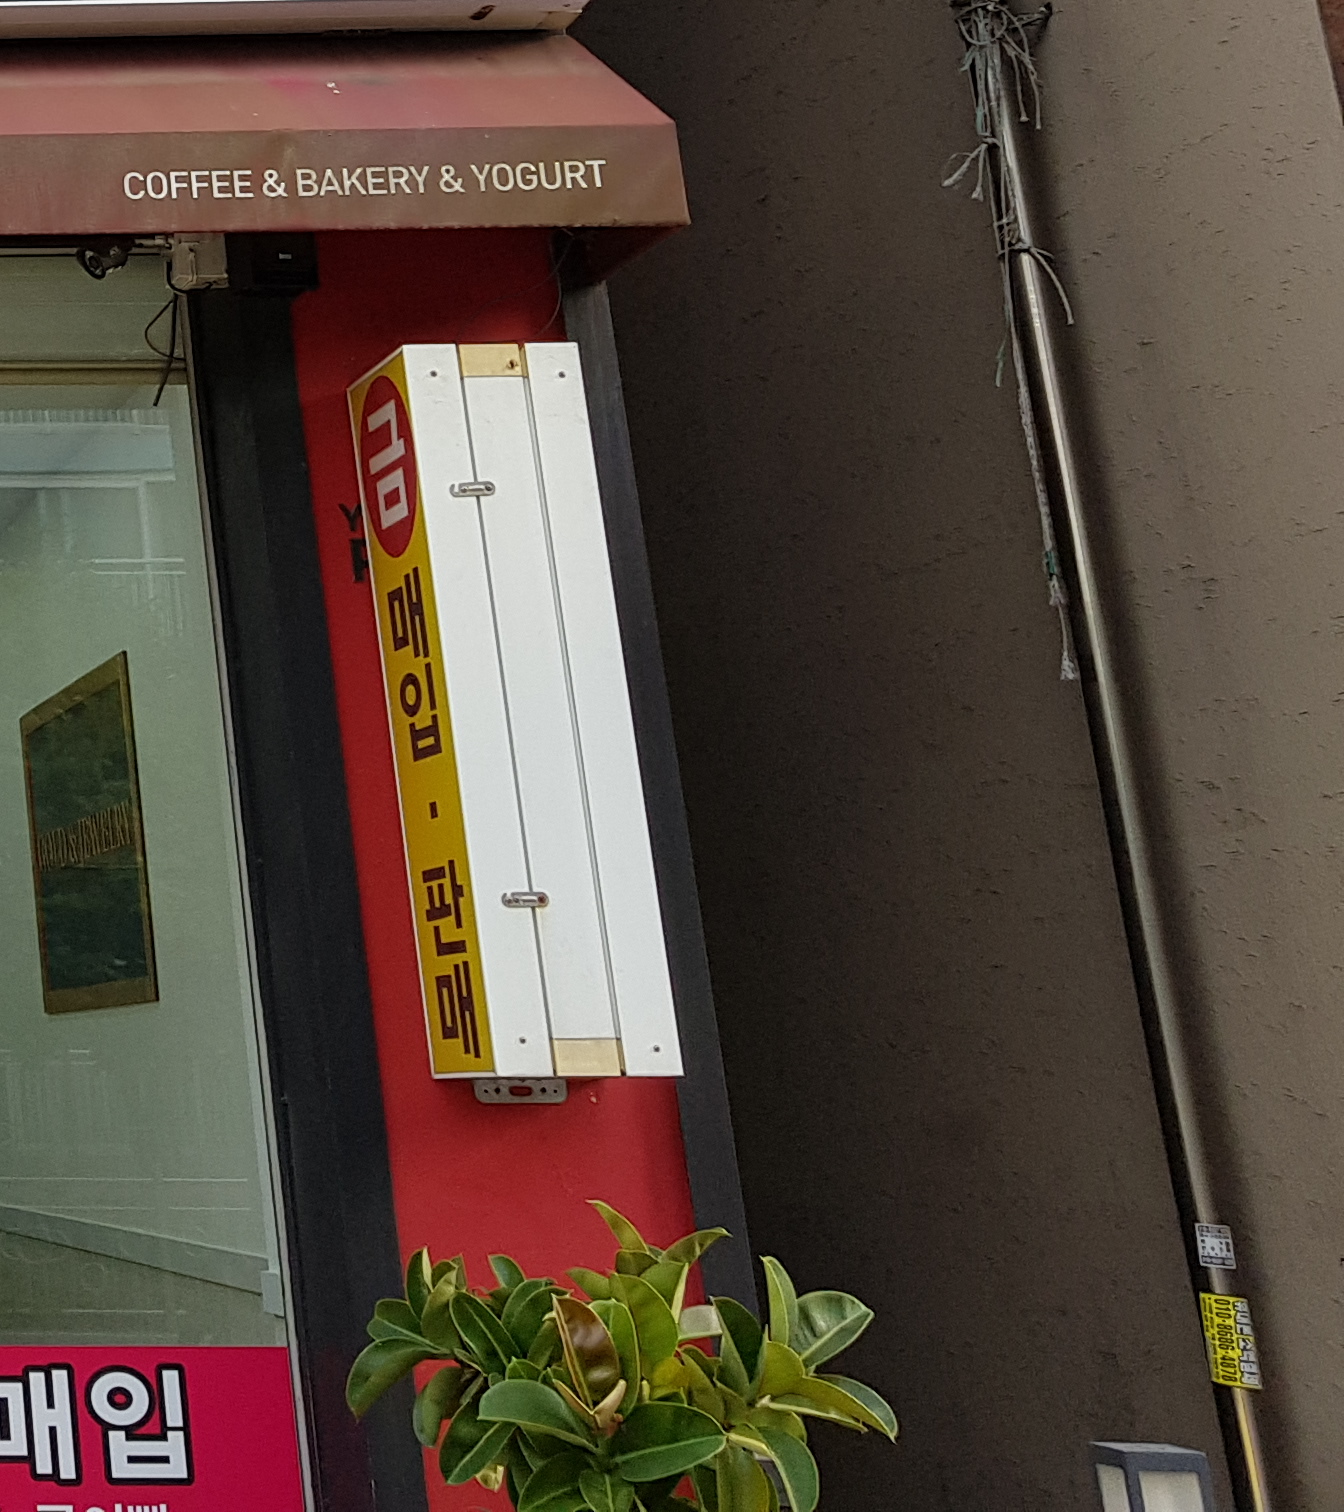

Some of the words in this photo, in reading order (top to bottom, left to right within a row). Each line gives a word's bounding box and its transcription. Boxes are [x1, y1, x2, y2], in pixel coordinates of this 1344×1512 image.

[123, 169, 254, 201] COFFEE
[261, 169, 288, 198] &
[296, 165, 429, 198] BAKERY
[438, 164, 464, 194] &
[470, 159, 607, 192] YOGURT
[366, 397, 407, 531] 금
[386, 565, 444, 763] 매입
[421, 859, 481, 1060] 판매
